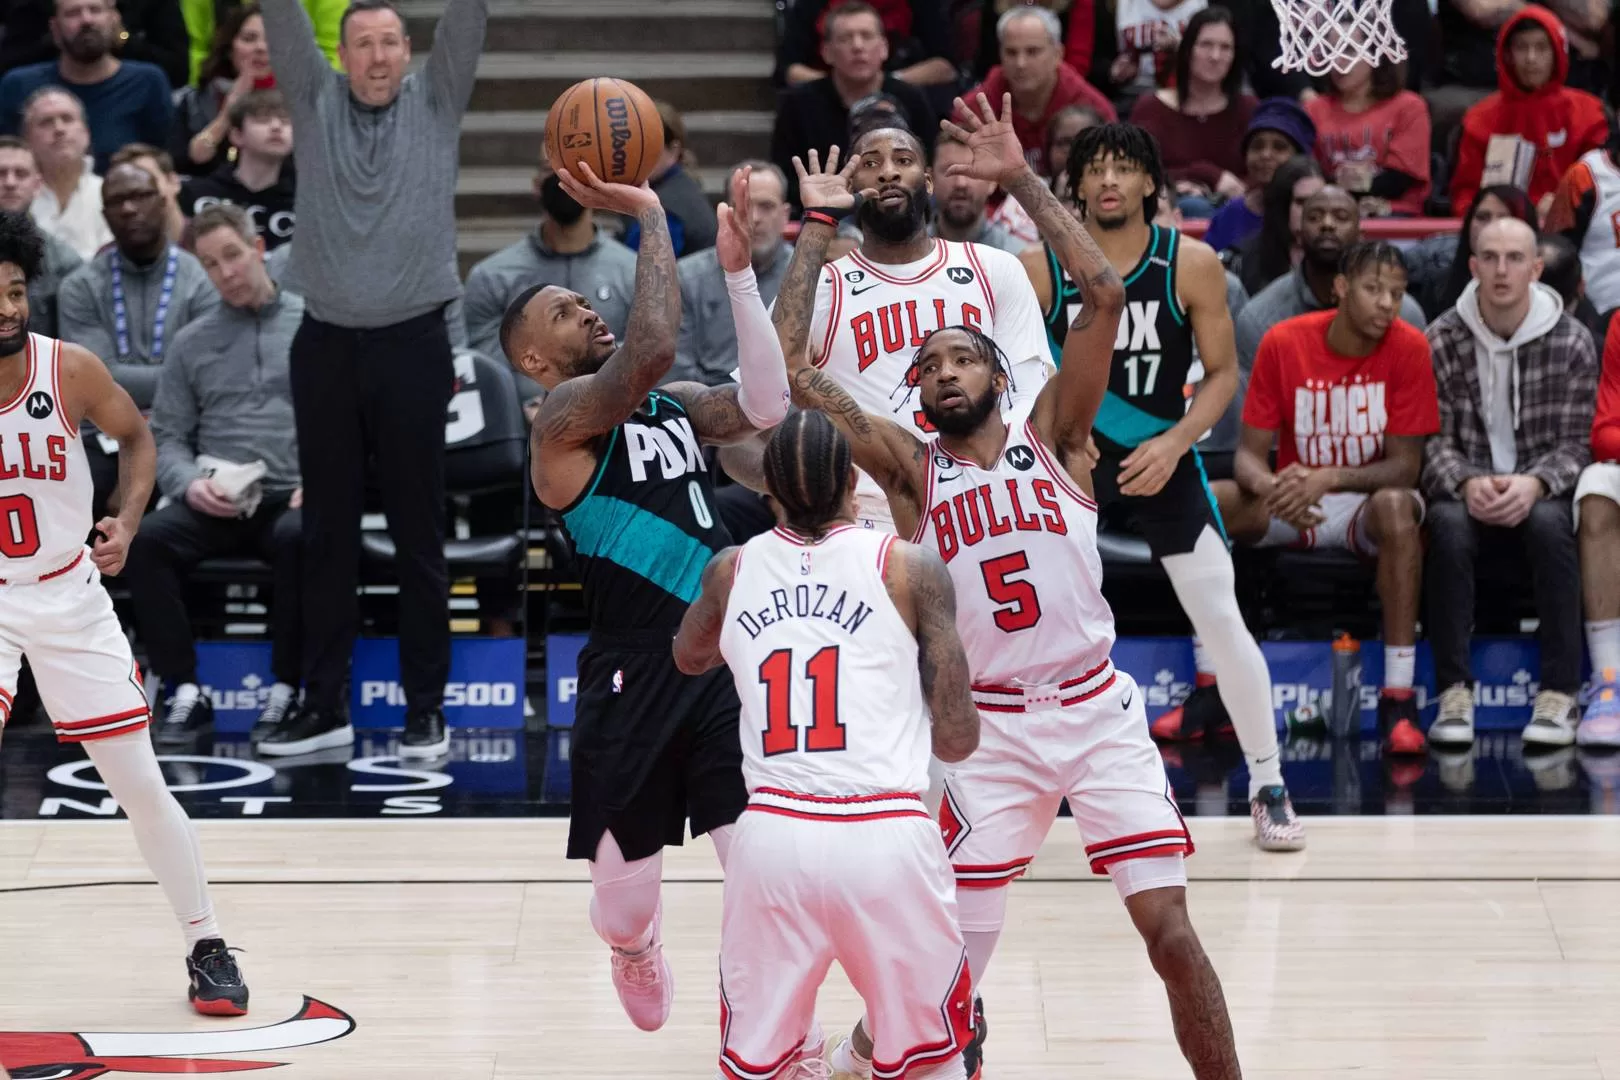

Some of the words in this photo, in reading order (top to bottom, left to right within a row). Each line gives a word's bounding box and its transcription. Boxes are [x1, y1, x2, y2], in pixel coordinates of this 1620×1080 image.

[605, 97, 632, 178] Wilson
[850, 299, 983, 374] BULLS
[1124, 354, 1162, 397] 17
[1294, 382, 1388, 437] BLACK
[623, 417, 708, 483] PDX
[0, 493, 41, 559] 0
[687, 480, 714, 530] 0
[930, 478, 1068, 565] BULLS
[979, 550, 1042, 634] 5
[361, 681, 516, 706] Pl500
[758, 644, 847, 758] 11
